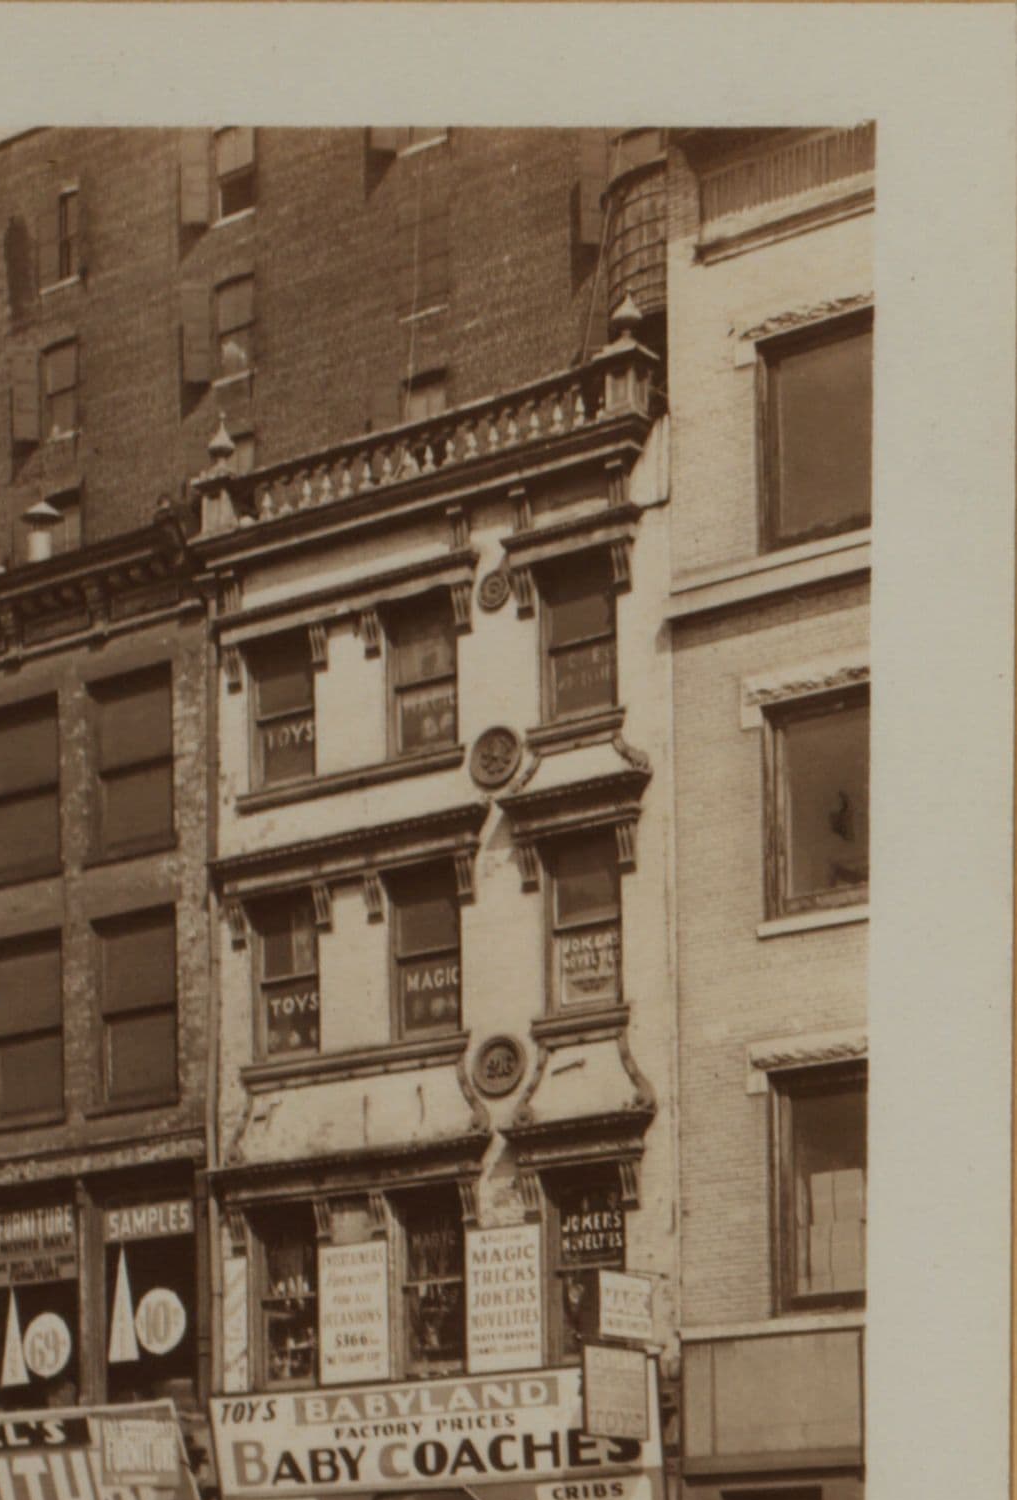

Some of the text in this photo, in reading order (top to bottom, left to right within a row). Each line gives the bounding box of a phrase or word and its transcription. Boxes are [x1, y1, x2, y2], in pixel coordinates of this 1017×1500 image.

[406, 965, 461, 992] MAGIC
[270, 992, 319, 1018] TOYS
[109, 1202, 190, 1240] SAMPLES
[561, 1211, 622, 1234] JOKERS
[472, 1245, 535, 1264] MAGIC
[472, 1265, 536, 1286] TRICKS
[474, 1287, 536, 1307] JOKERS
[220, 1400, 277, 1425] TOYS
[304, 1378, 549, 1421] BABYLAND
[333, 1412, 517, 1441] FACTORY PRICES
[231, 1440, 367, 1488] BABY
[377, 1428, 643, 1481] COACHES
[551, 1482, 624, 1500] CRIBS
